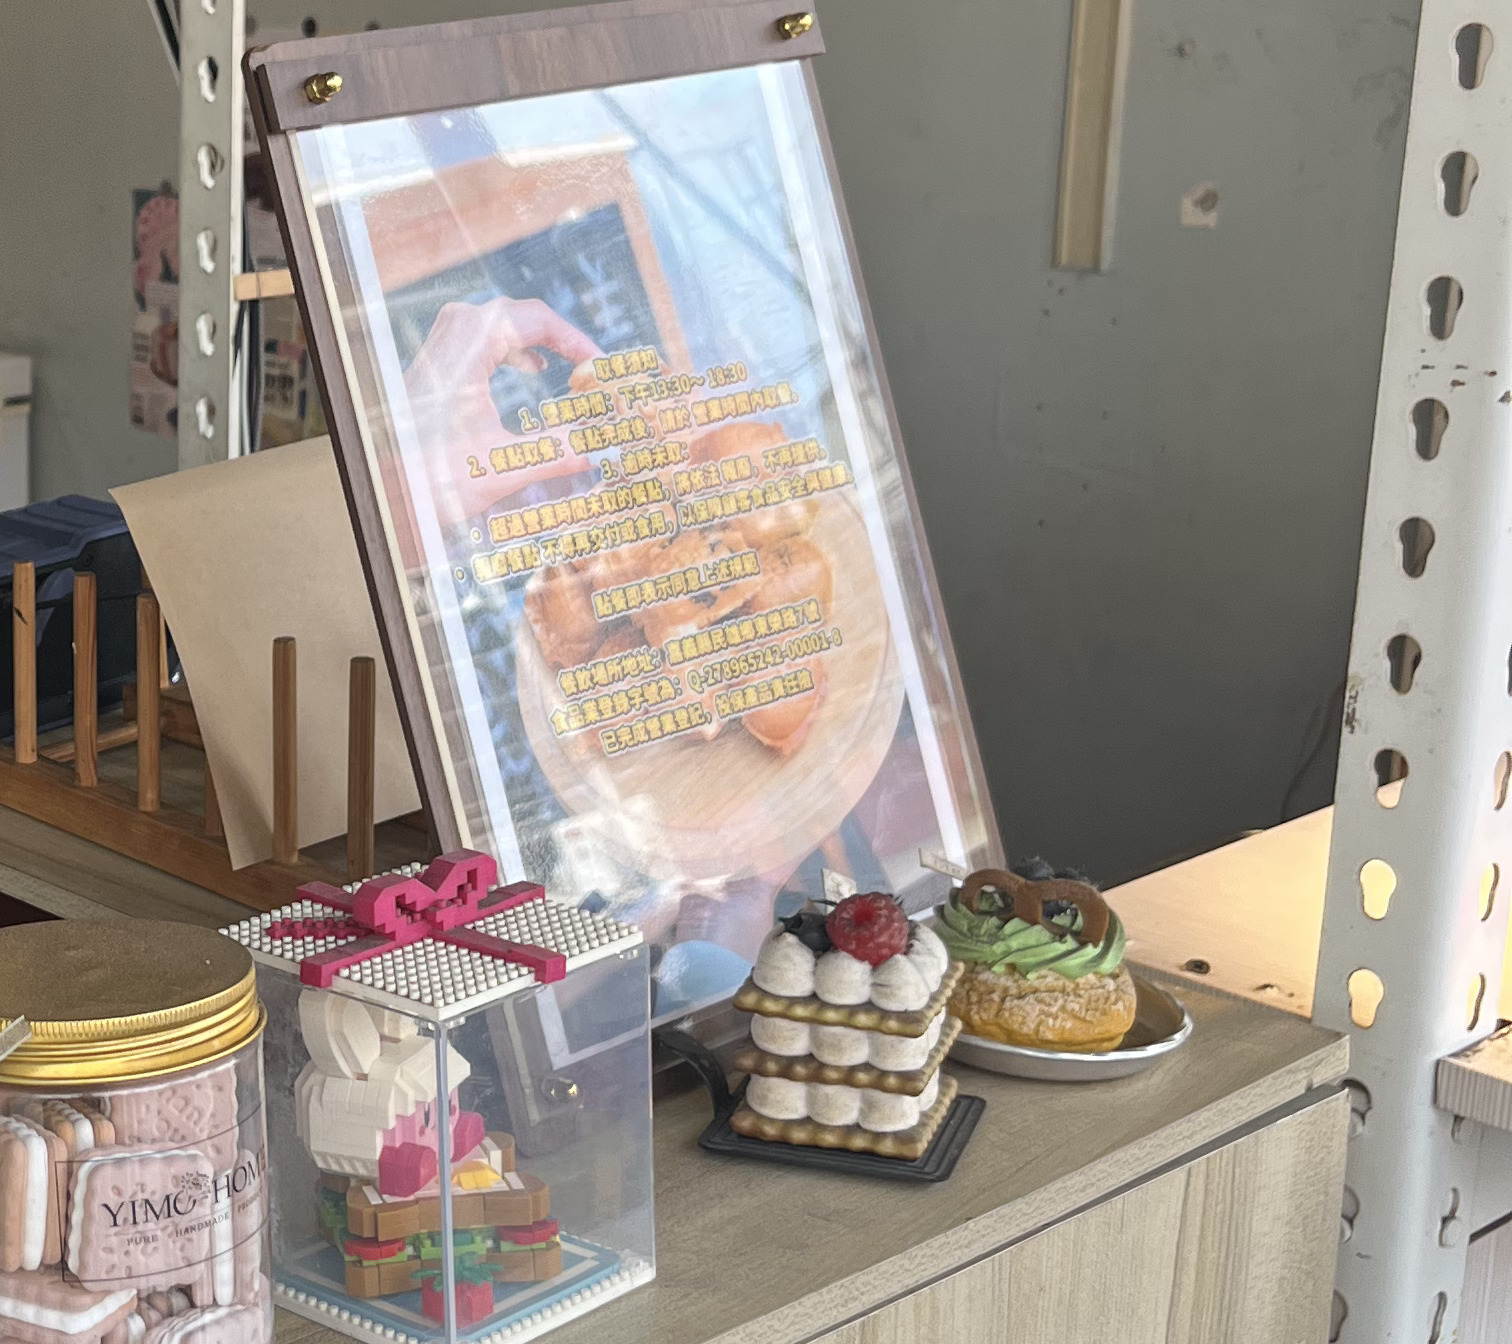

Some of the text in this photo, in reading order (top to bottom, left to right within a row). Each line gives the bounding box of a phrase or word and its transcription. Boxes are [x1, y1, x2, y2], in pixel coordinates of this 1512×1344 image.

[593, 348, 658, 382] 取餐須知
[520, 409, 540, 430] 1.
[467, 456, 486, 478] 2.
[600, 459, 619, 479] 3.
[126, 1234, 159, 1247] PURE
[175, 1211, 230, 1238] HANDMADE
